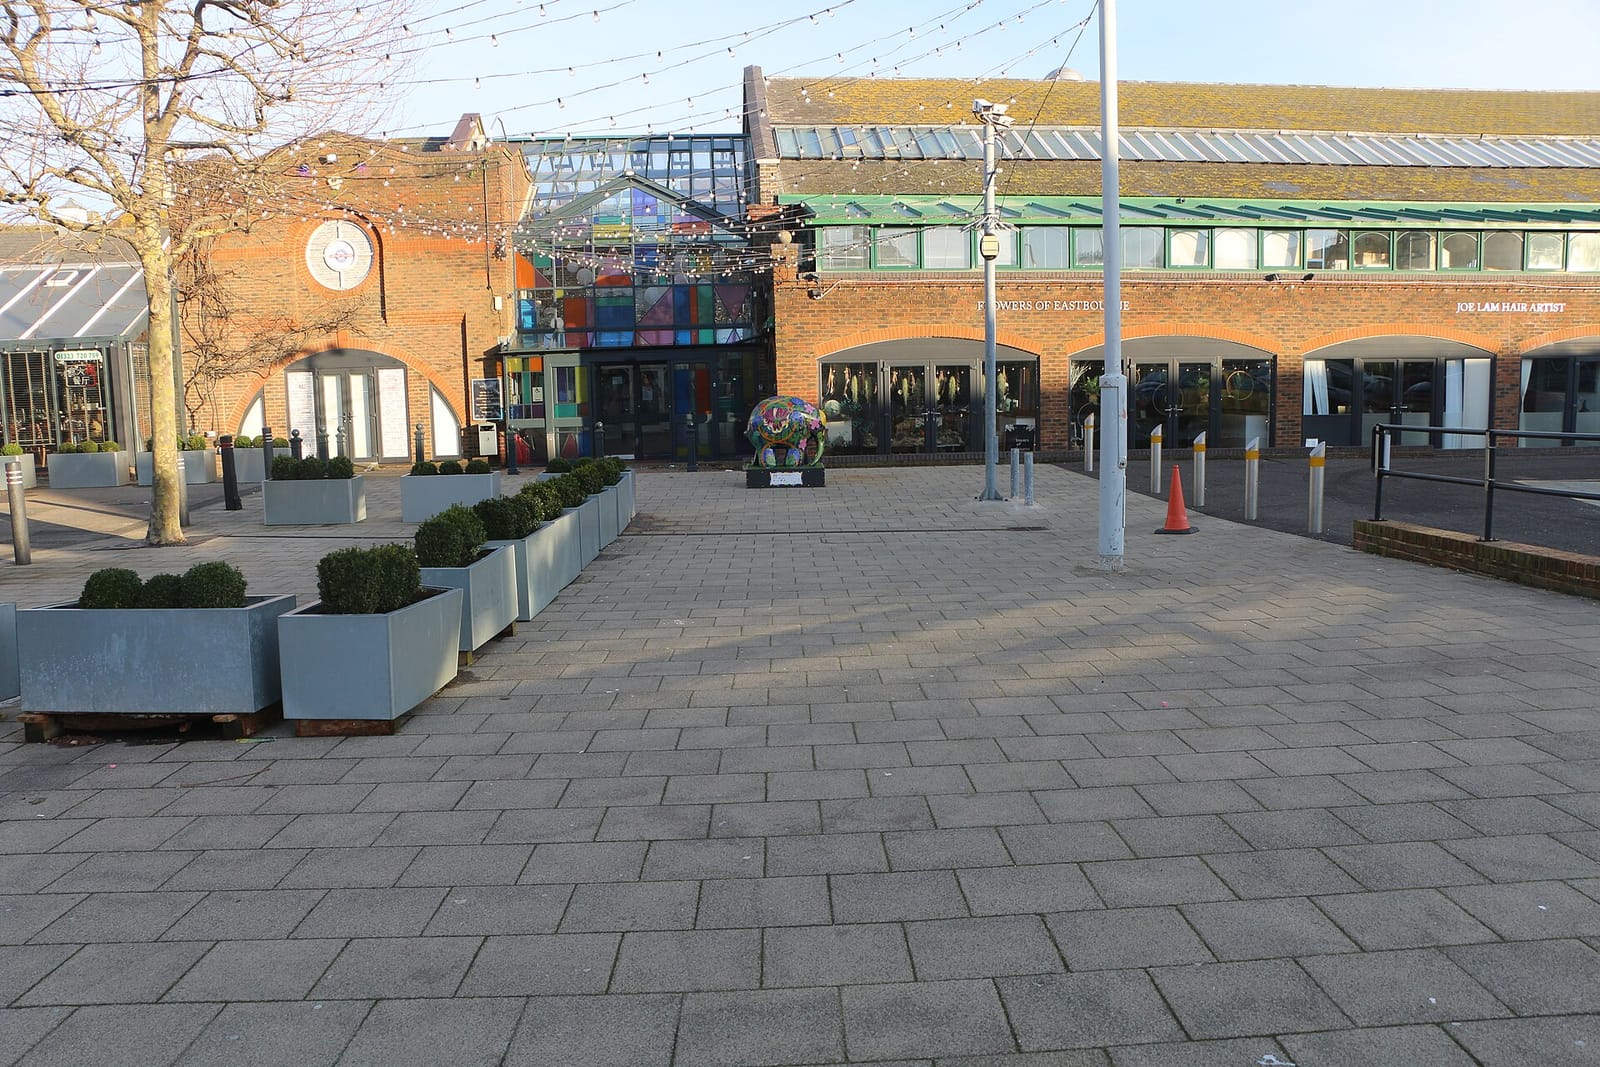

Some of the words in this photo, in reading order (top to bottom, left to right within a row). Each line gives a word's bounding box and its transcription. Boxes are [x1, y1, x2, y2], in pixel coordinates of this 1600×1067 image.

[977, 301, 1033, 311] FOWERS
[1035, 301, 1051, 311] OF
[1456, 302, 1475, 313] JOE
[1477, 302, 1500, 312] LAM
[1501, 302, 1528, 312] HAIR
[1529, 303, 1566, 313] ARTIST
